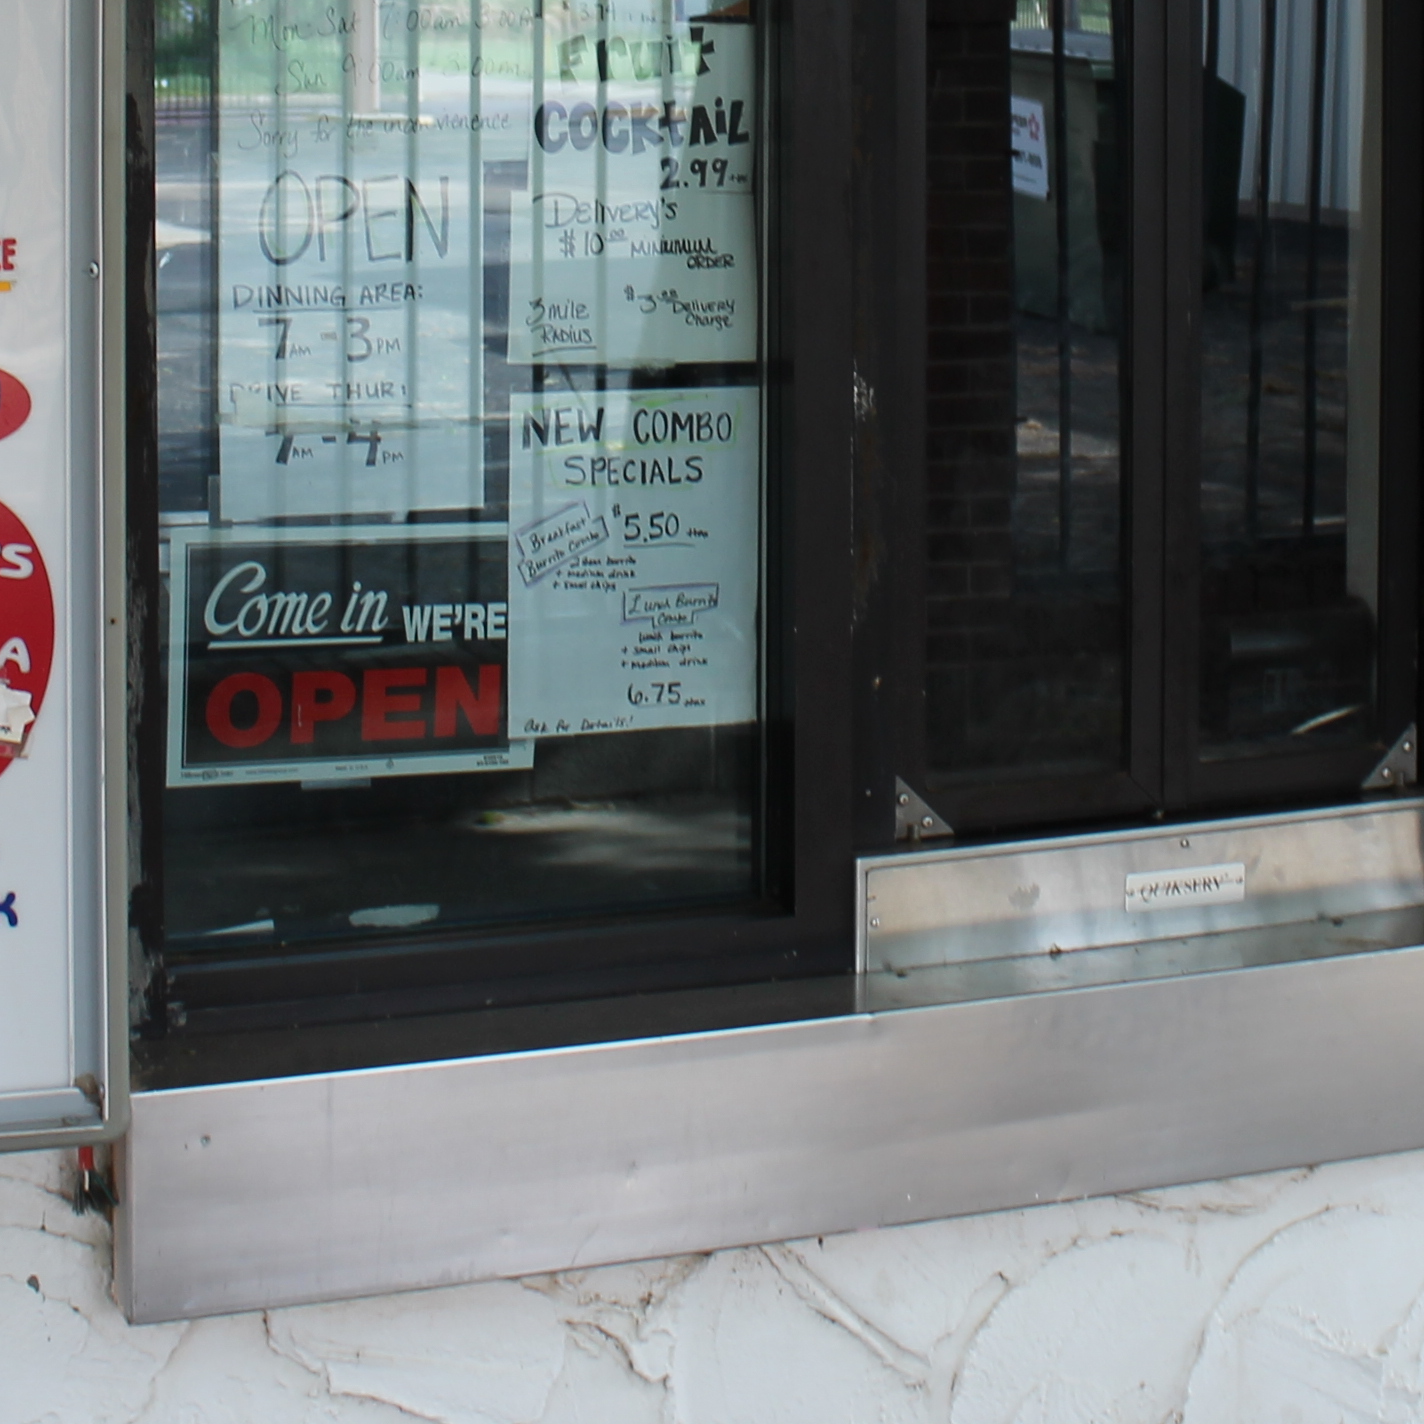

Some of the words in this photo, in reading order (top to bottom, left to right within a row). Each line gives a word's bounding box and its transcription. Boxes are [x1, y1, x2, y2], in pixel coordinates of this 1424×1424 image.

[659, 156, 730, 191] 2.99
[258, 169, 450, 267] OPEN
[233, 284, 345, 310] DINNING
[521, 407, 605, 450] NEW
[632, 408, 734, 445] COMBO
[564, 457, 705, 487] SPECIALS
[204, 560, 329, 637] Come
[340, 580, 389, 634] in
[402, 602, 507, 643] WE'RE
[205, 663, 502, 749] OPEN
[627, 681, 683, 706] 6.75
